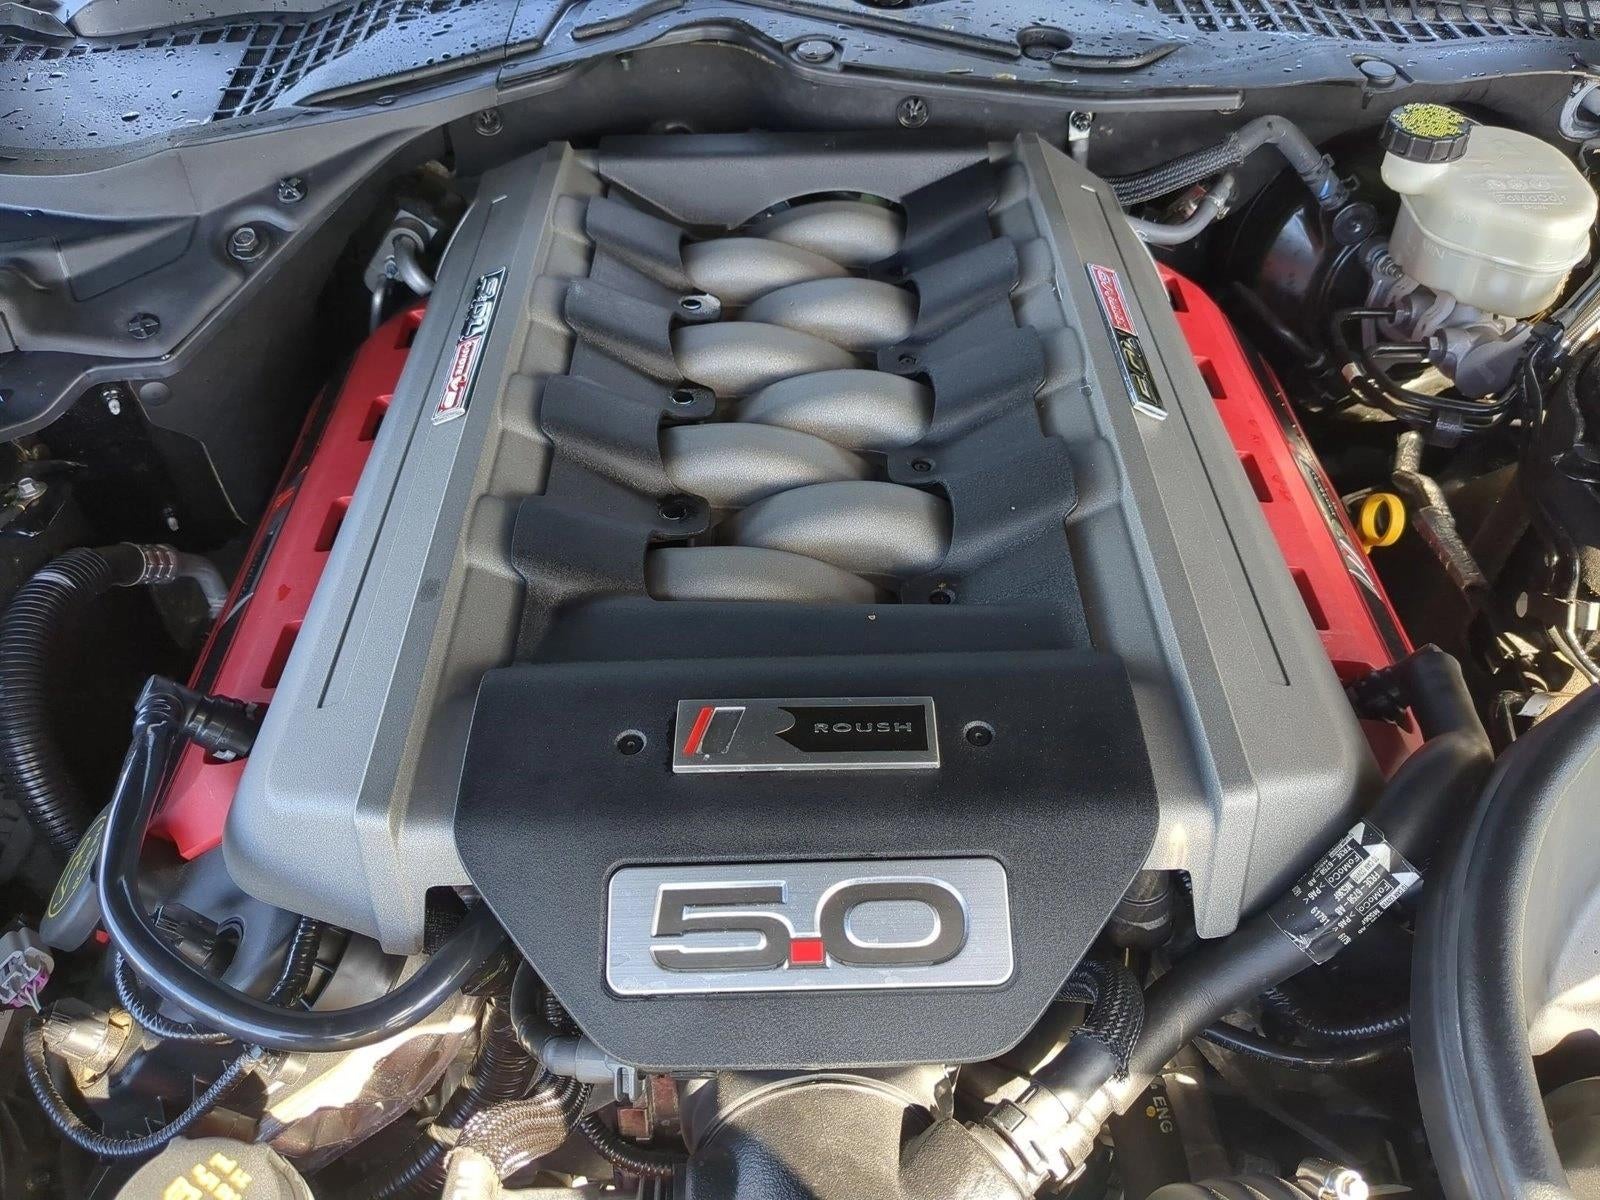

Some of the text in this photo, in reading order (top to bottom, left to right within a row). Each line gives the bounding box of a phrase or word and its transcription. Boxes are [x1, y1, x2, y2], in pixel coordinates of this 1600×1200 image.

[814, 722, 912, 733] ROUSH
[1328, 853, 1363, 883] FoMoCo
[1358, 882, 1390, 912] FoMoCo
[650, 876, 969, 972] 5.0
[1152, 1096, 1173, 1133] ENG
